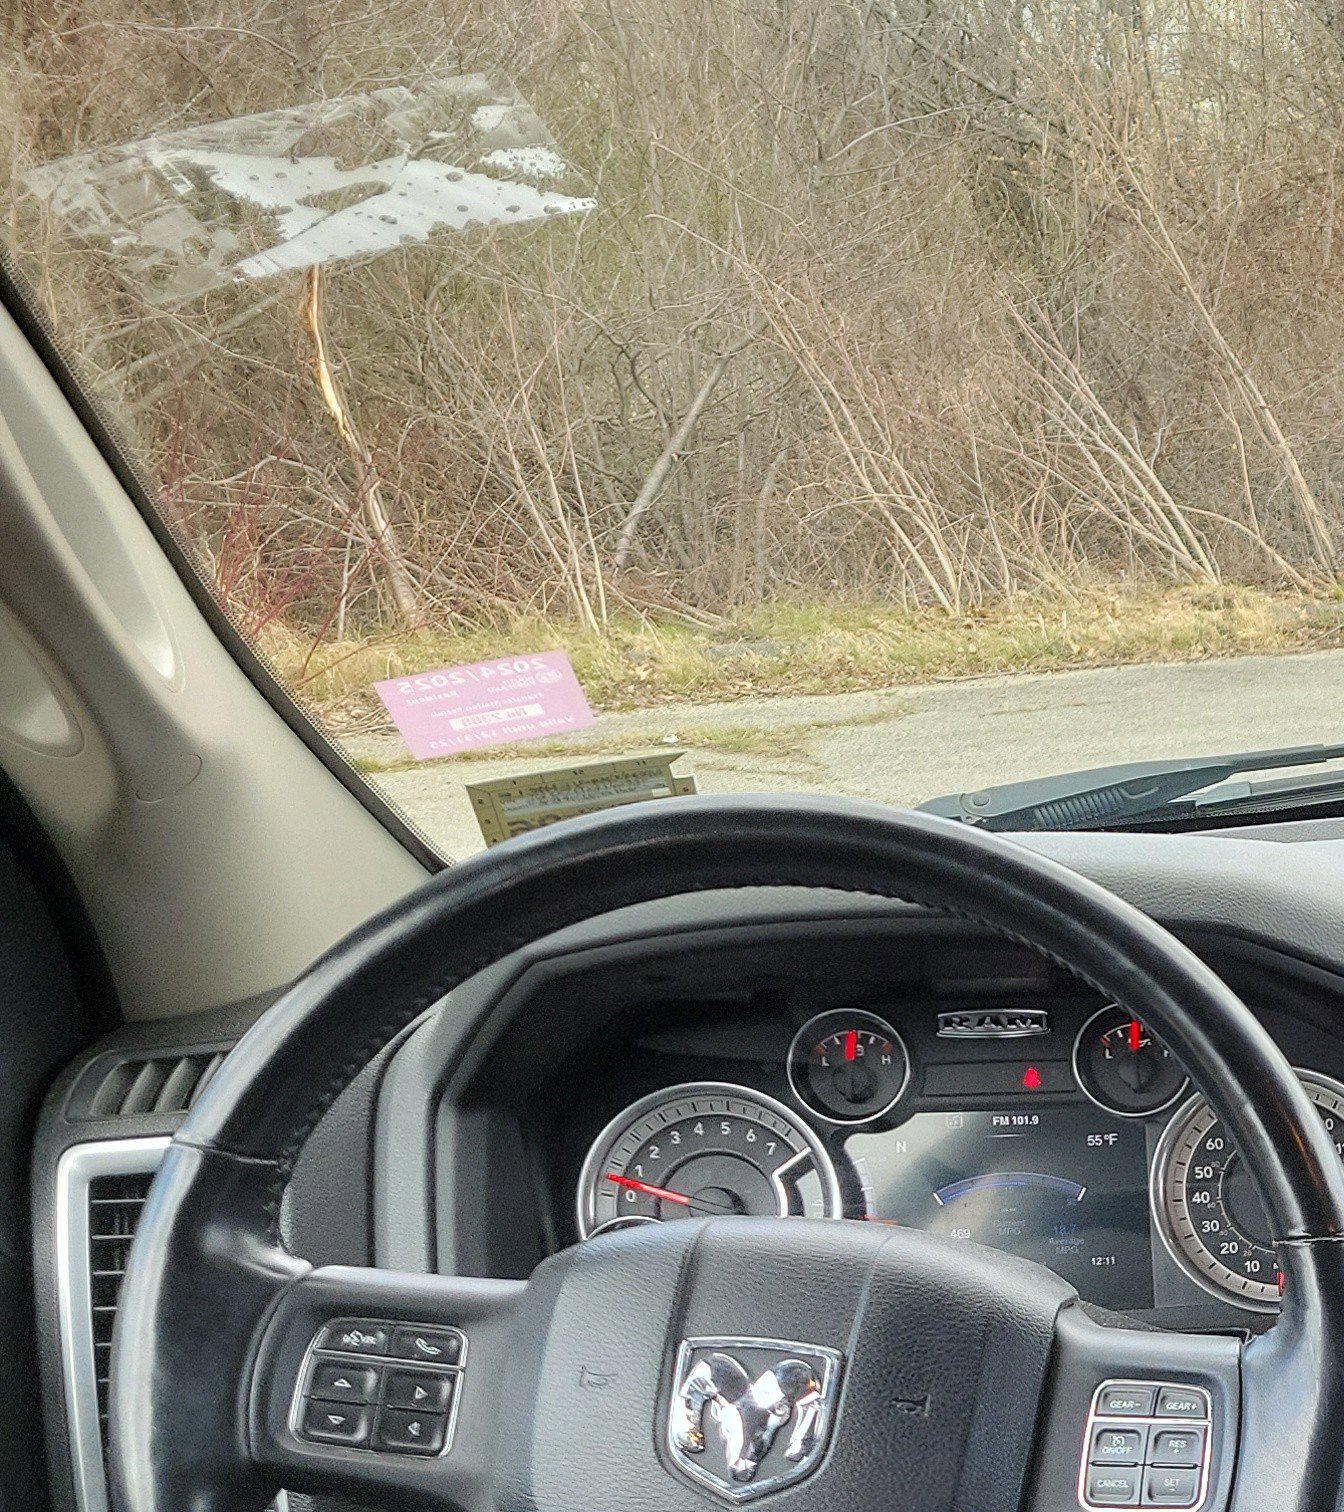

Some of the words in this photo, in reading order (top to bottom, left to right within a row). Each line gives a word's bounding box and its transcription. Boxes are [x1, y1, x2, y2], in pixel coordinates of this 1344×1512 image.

[992, 1116, 1009, 1126] FM
[1012, 1115, 1039, 1126] 101.9
[694, 1123, 705, 1135] 4
[721, 1122, 731, 1134] 5
[670, 1131, 681, 1143] 3
[746, 1129, 756, 1142] 6
[766, 1142, 776, 1155] 7
[1206, 1138, 1223, 1150] 60
[649, 1146, 661, 1158] 2
[636, 1165, 643, 1176] 1
[1195, 1167, 1213, 1178] 50
[626, 1191, 637, 1202] 0
[1192, 1192, 1210, 1203] 40
[1202, 1220, 1219, 1232] 30
[1220, 1242, 1238, 1254] 20
[1091, 1256, 1116, 1265] 12:11
[1244, 1261, 1260, 1272] 10
[1097, 1480, 1129, 1488] CANCEL
